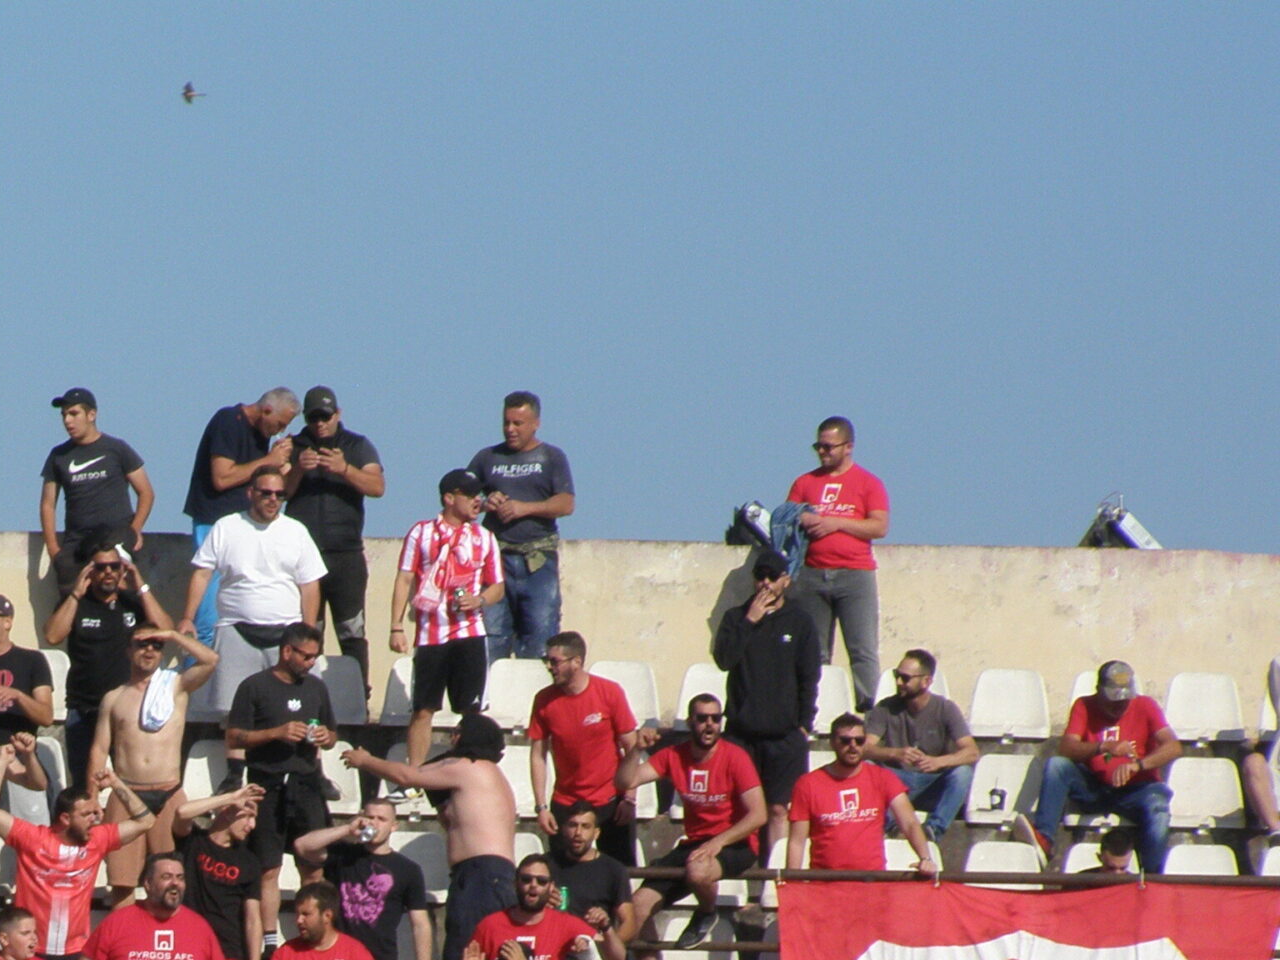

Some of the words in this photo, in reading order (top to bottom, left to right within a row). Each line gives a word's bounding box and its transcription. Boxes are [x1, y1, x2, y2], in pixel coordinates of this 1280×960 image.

[492, 463, 543, 474] HILFIGER
[72, 473, 88, 483] JUST
[88, 471, 100, 480] DO
[128, 950, 172, 960] PYRGOS
